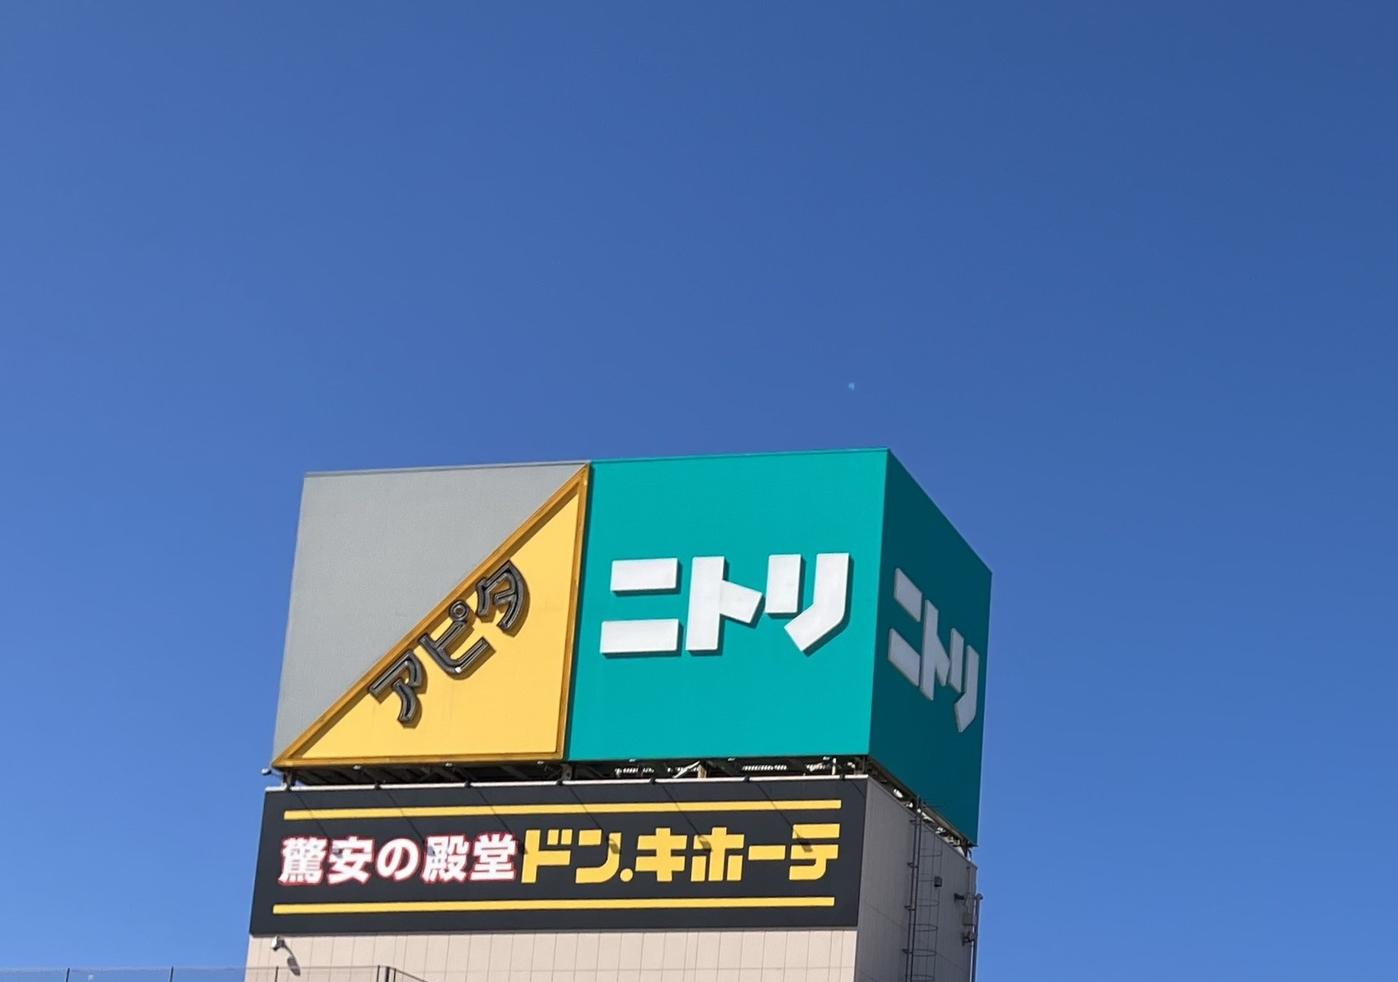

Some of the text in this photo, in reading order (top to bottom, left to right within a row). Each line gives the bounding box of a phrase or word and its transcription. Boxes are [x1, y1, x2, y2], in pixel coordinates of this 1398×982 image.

[369, 559, 529, 730] アピタ
[601, 552, 850, 655] ニトリ
[887, 567, 980, 733] ニトリ
[279, 832, 517, 885] 驚安の殿堂
